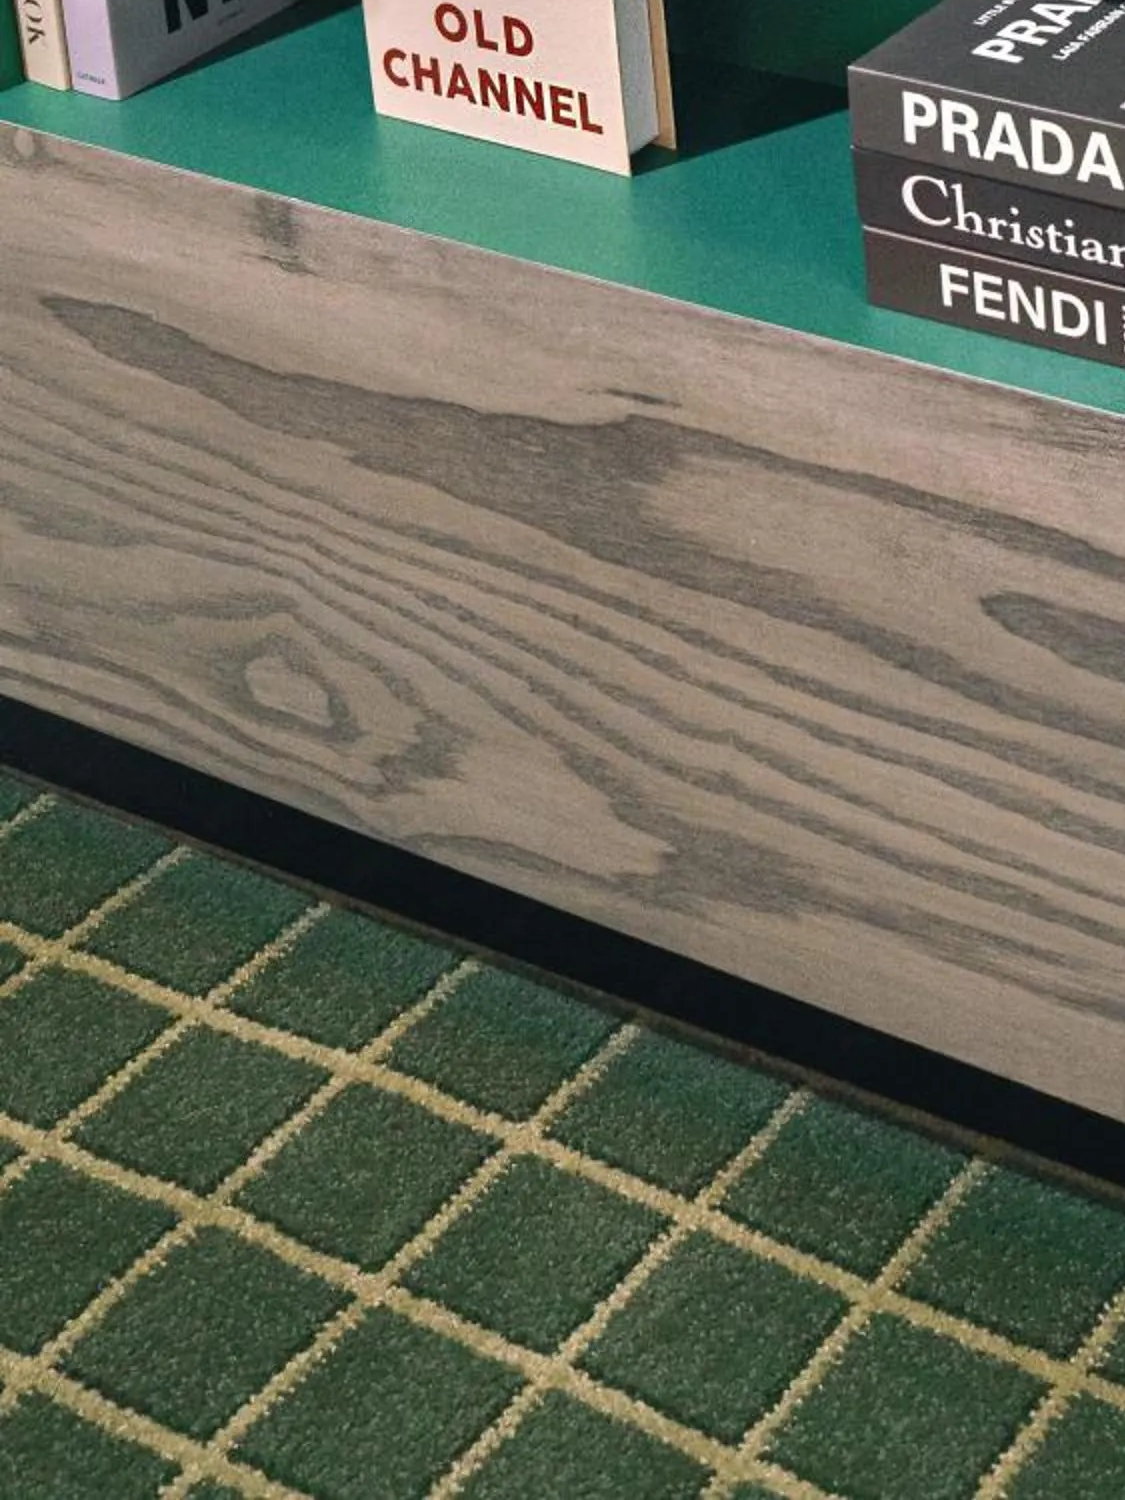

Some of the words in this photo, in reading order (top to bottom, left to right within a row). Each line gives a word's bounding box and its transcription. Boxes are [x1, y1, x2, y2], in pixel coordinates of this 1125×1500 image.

[433, 2, 535, 58] OLD
[382, 48, 604, 136] CHANNEL
[901, 89, 1125, 192] PRADA
[939, 263, 1108, 346] FENDI
